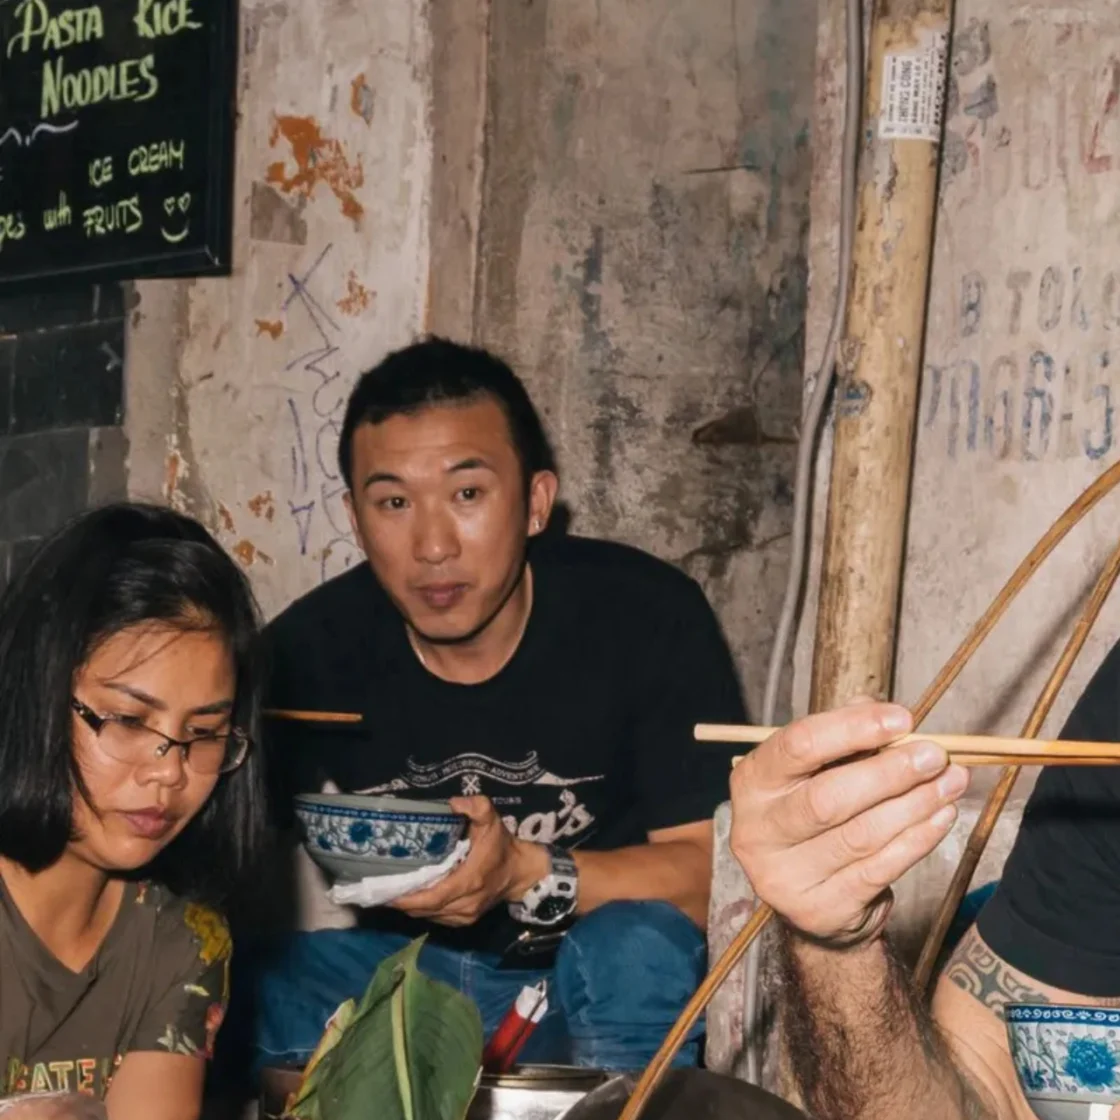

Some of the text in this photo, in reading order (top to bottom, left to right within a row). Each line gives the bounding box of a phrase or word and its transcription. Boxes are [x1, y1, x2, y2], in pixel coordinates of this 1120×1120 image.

[7, 0, 202, 58] PASTA RICE
[41, 55, 158, 118] NOODLES
[88, 140, 185, 188] ICE CREAM
[83, 194, 142, 237] FRUITS
